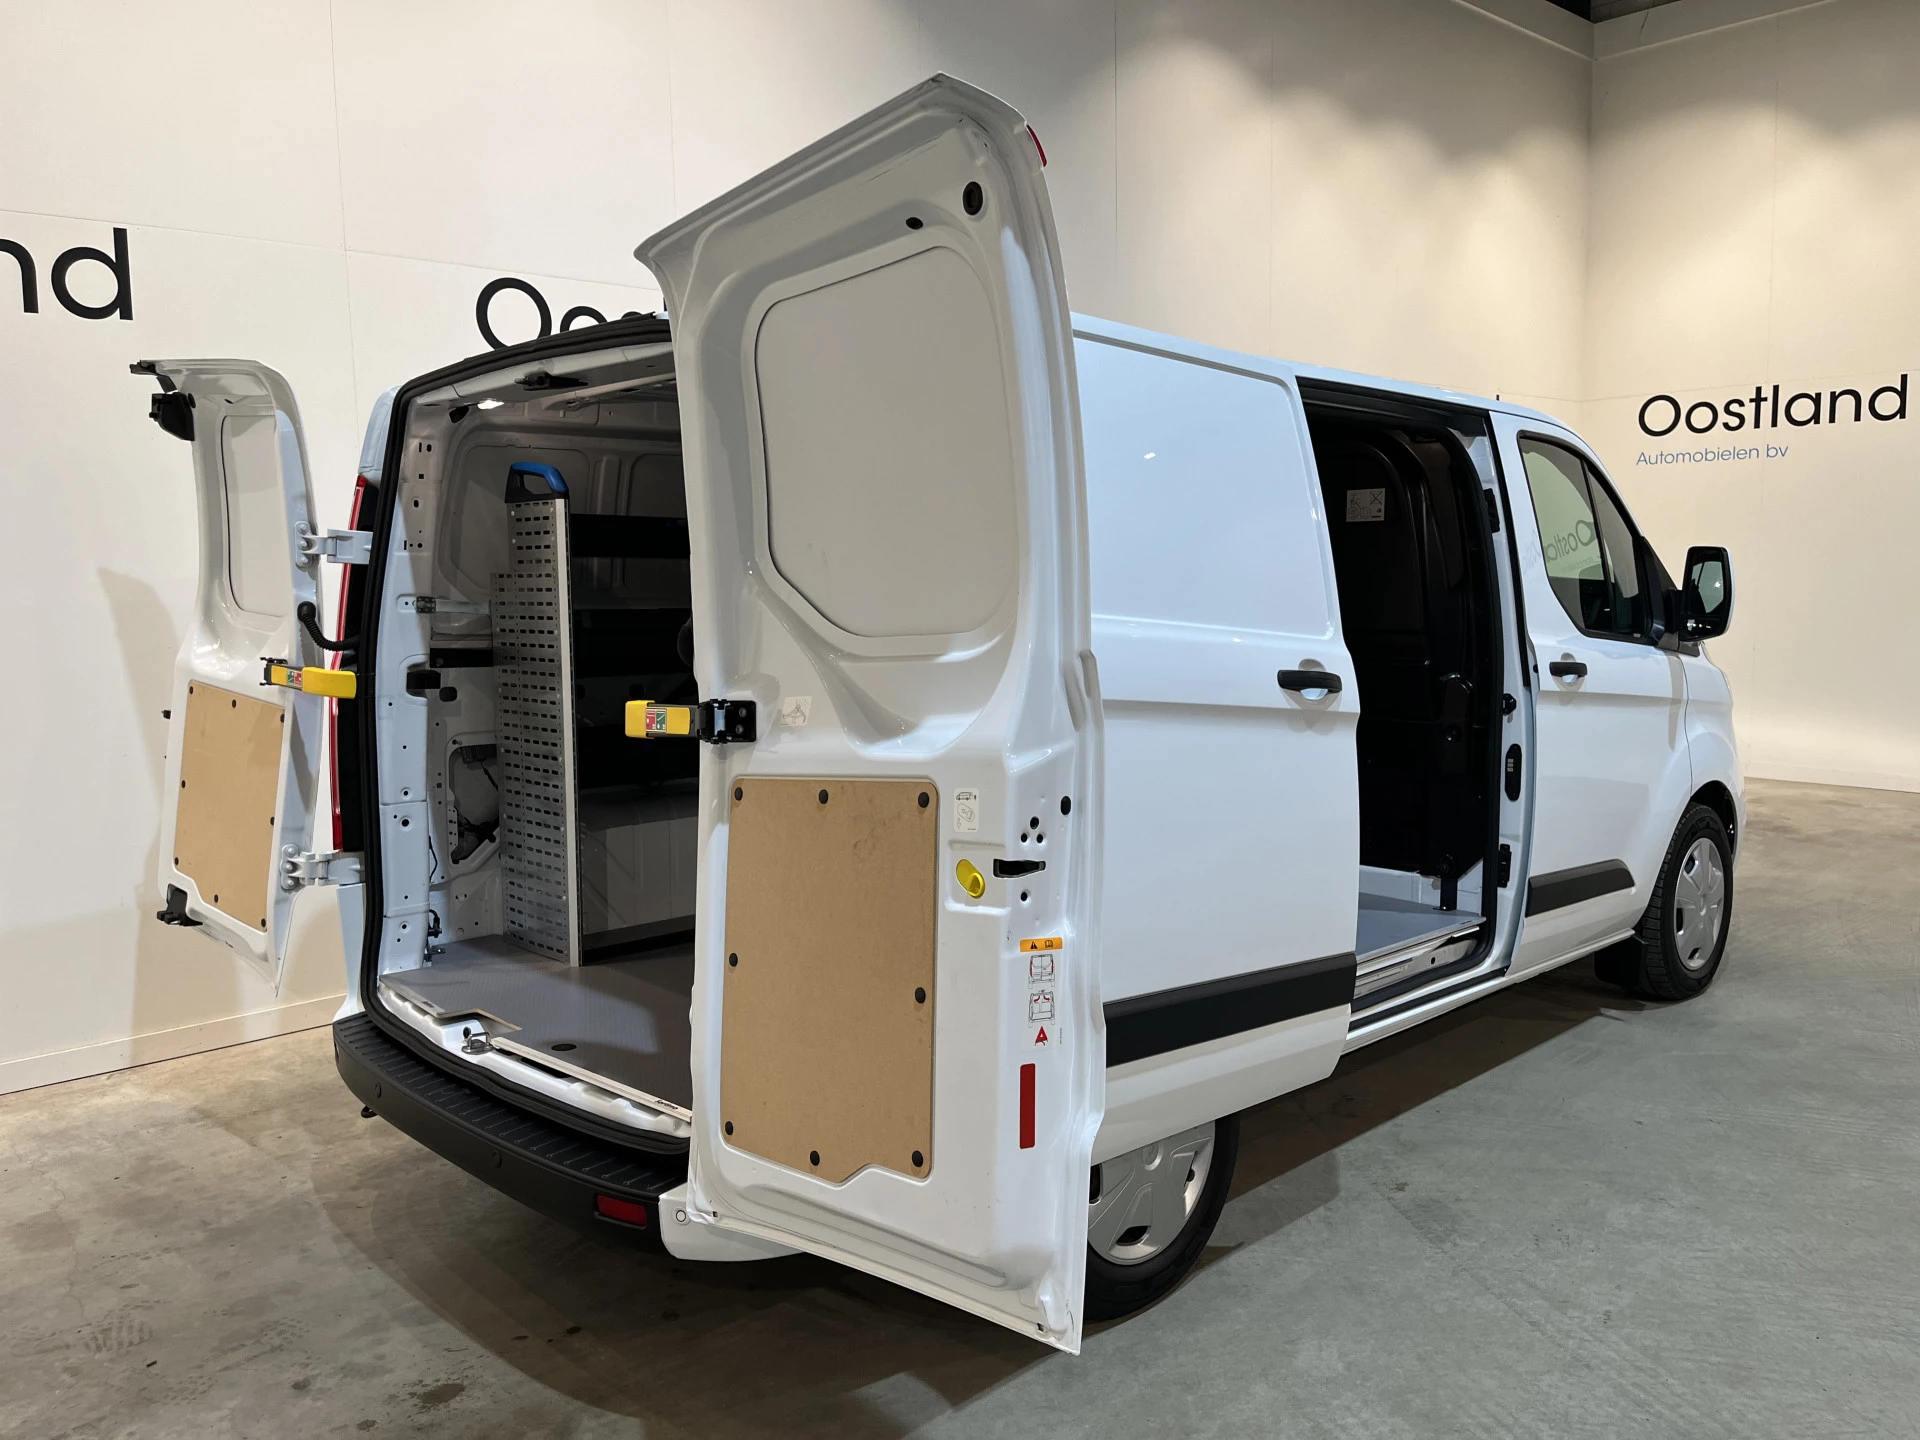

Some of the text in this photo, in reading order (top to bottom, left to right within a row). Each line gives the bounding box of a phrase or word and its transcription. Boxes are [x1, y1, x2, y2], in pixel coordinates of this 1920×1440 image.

[1638, 374, 1908, 437] Oostland
[1636, 444, 1789, 466] Automobielen bv
